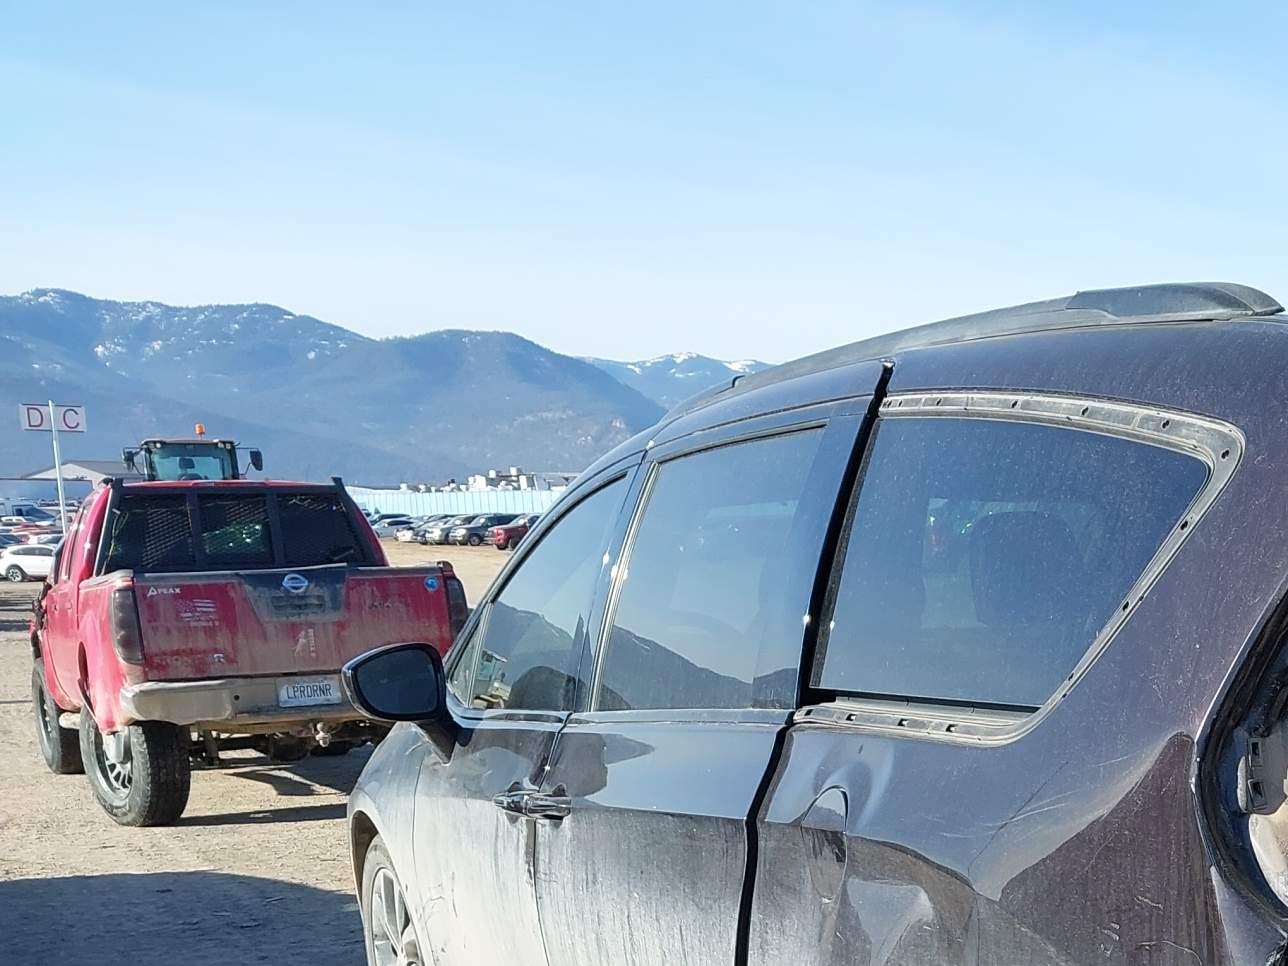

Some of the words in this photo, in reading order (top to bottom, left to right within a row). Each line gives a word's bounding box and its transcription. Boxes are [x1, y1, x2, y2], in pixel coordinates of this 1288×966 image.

[27, 407, 43, 427] D
[63, 408, 79, 429] C
[286, 683, 333, 700] LPRDRNR
